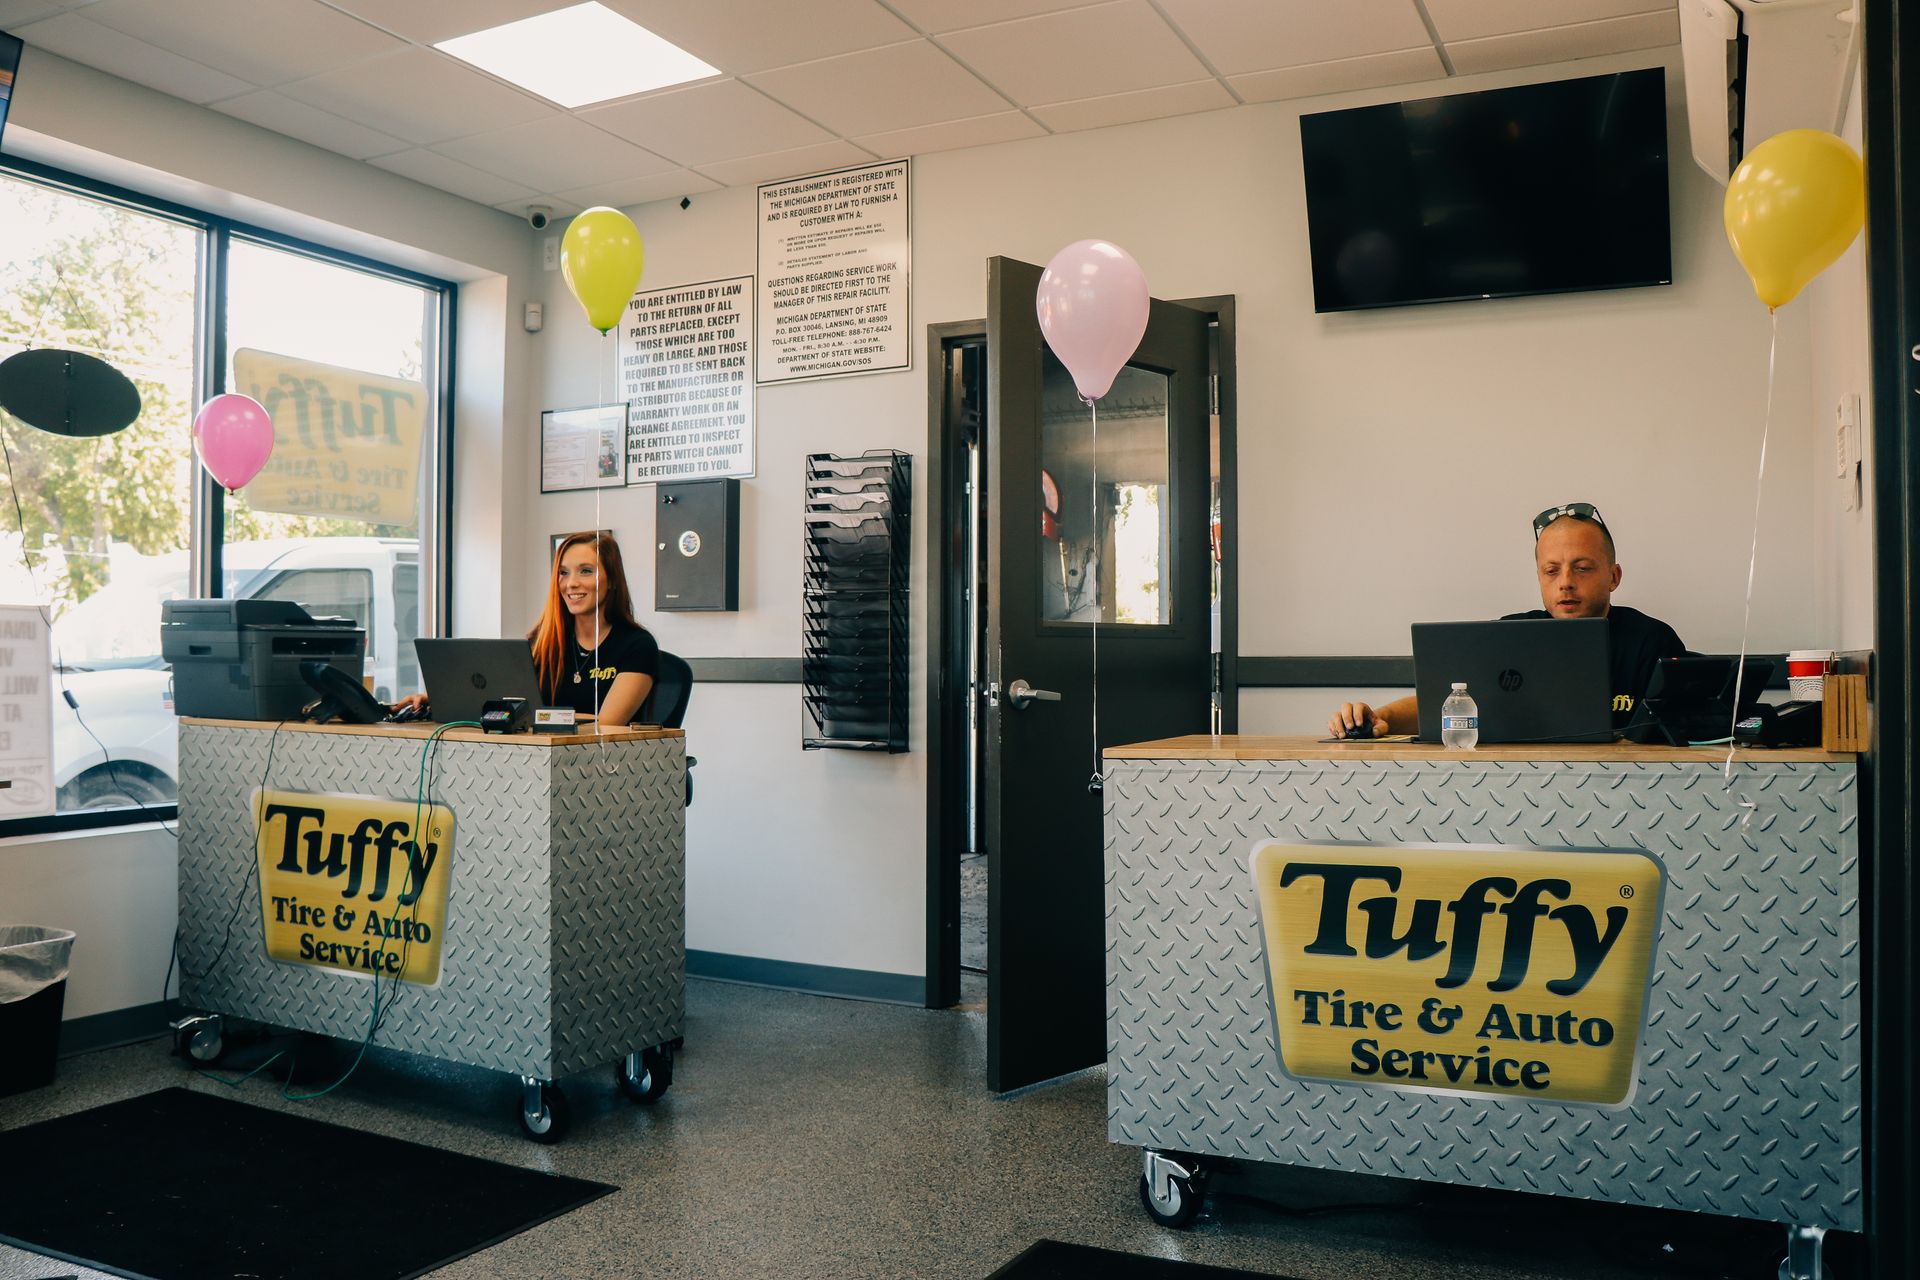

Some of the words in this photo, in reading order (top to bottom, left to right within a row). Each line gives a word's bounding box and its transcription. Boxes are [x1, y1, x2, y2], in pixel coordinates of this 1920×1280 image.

[764, 190, 777, 199] THIS
[780, 180, 831, 197] ESTABLISHMENT
[834, 179, 840, 187] IS
[842, 171, 882, 186] REGISTERED
[885, 168, 902, 178] WITH
[771, 201, 782, 210] THE
[784, 195, 815, 207] MICHIGAN
[818, 187, 861, 202] DEPARTMENT
[863, 185, 871, 194] OF
[874, 181, 895, 192] STATE
[768, 213, 780, 222] AND
[790, 206, 822, 218] REQUIRED
[824, 204, 832, 212] BY
[835, 201, 848, 210] LAW
[851, 200, 859, 208] TO
[862, 194, 890, 206] FURNISH
[800, 215, 835, 228] CUSTOMER
[838, 212, 854, 222] WITH
[768, 276, 804, 288] QUESTIONS
[806, 270, 844, 282] REGARDING
[846, 265, 874, 277] SERVICE
[876, 262, 896, 272] WORK
[774, 288, 799, 298] SHOULD
[811, 281, 843, 293] DIRECTED
[845, 278, 864, 288] FIRST
[866, 277, 875, 285] TO
[878, 274, 890, 283] THE
[629, 299, 646, 310] YOU
[648, 296, 663, 307] ARE
[667, 290, 705, 305] ENTITLED
[708, 288, 719, 298] BY
[722, 284, 741, 296] LAW
[774, 298, 804, 309] MANAGER
[807, 296, 814, 305] OF
[817, 294, 832, 303] THIS
[834, 290, 857, 301] REPAIR
[638, 312, 648, 323] TO
[651, 310, 666, 321] THE
[669, 304, 702, 318] RETURN
[705, 302, 715, 313] OF
[717, 300, 732, 311] ALL
[777, 314, 808, 325] MICHIGAN
[810, 308, 853, 321] DEPARTMENT
[856, 306, 864, 315] OF
[866, 303, 887, 314] STATE
[868, 315, 887, 324] 48909
[631, 325, 657, 338] PARTS
[708, 313, 740, 327] EXCEPT
[636, 338, 662, 351] THOSE
[665, 334, 695, 347] WHICH
[698, 331, 714, 343] ARE
[717, 328, 735, 340] TOO
[772, 336, 804, 346] TOLL-FREE
[624, 354, 650, 366] HEAVY
[653, 352, 664, 363] OR
[698, 345, 716, 357] AND
[718, 341, 747, 354] THOSE
[778, 353, 819, 364] DEPARTMENT
[832, 349, 851, 357] STATE
[626, 366, 666, 380] REQUIRED
[670, 364, 680, 375] TO
[683, 362, 693, 373] BE
[696, 359, 718, 372] SENT
[721, 356, 745, 368] BACK
[627, 383, 638, 394] TO
[640, 381, 655, 392] THE
[658, 372, 728, 390] MANUFACTURER
[732, 371, 744, 382] OR
[629, 392, 686, 408] DISTRIBUTOR
[689, 387, 729, 401] BECAUSE
[732, 385, 743, 396] OF
[632, 407, 680, 421] WARRANTY
[682, 404, 710, 416] WORK
[712, 402, 724, 413] OR
[727, 400, 738, 411] AN
[727, 414, 745, 426] YOU
[630, 439, 645, 450] ARE
[648, 435, 686, 448] ENTITLED
[689, 434, 699, 444] TO
[702, 429, 740, 443] INSPECT
[645, 450, 672, 462] PARTS
[707, 444, 743, 456] CANNOT
[638, 467, 648, 477] BE
[651, 463, 695, 476] RETURNED
[697, 461, 708, 472] TO
[1612, 694, 1634, 711] ffy
[264, 804, 438, 906] Tuffy
[272, 896, 326, 928] Tire
[333, 904, 355, 931] &
[362, 909, 432, 944] Auto
[1280, 862, 1629, 996] Tuffy
[300, 932, 401, 974] Service
[1294, 988, 1402, 1031] Tire
[1417, 997, 1463, 1035] &
[1476, 1003, 1614, 1048] Auto
[1350, 1038, 1551, 1091] Service
